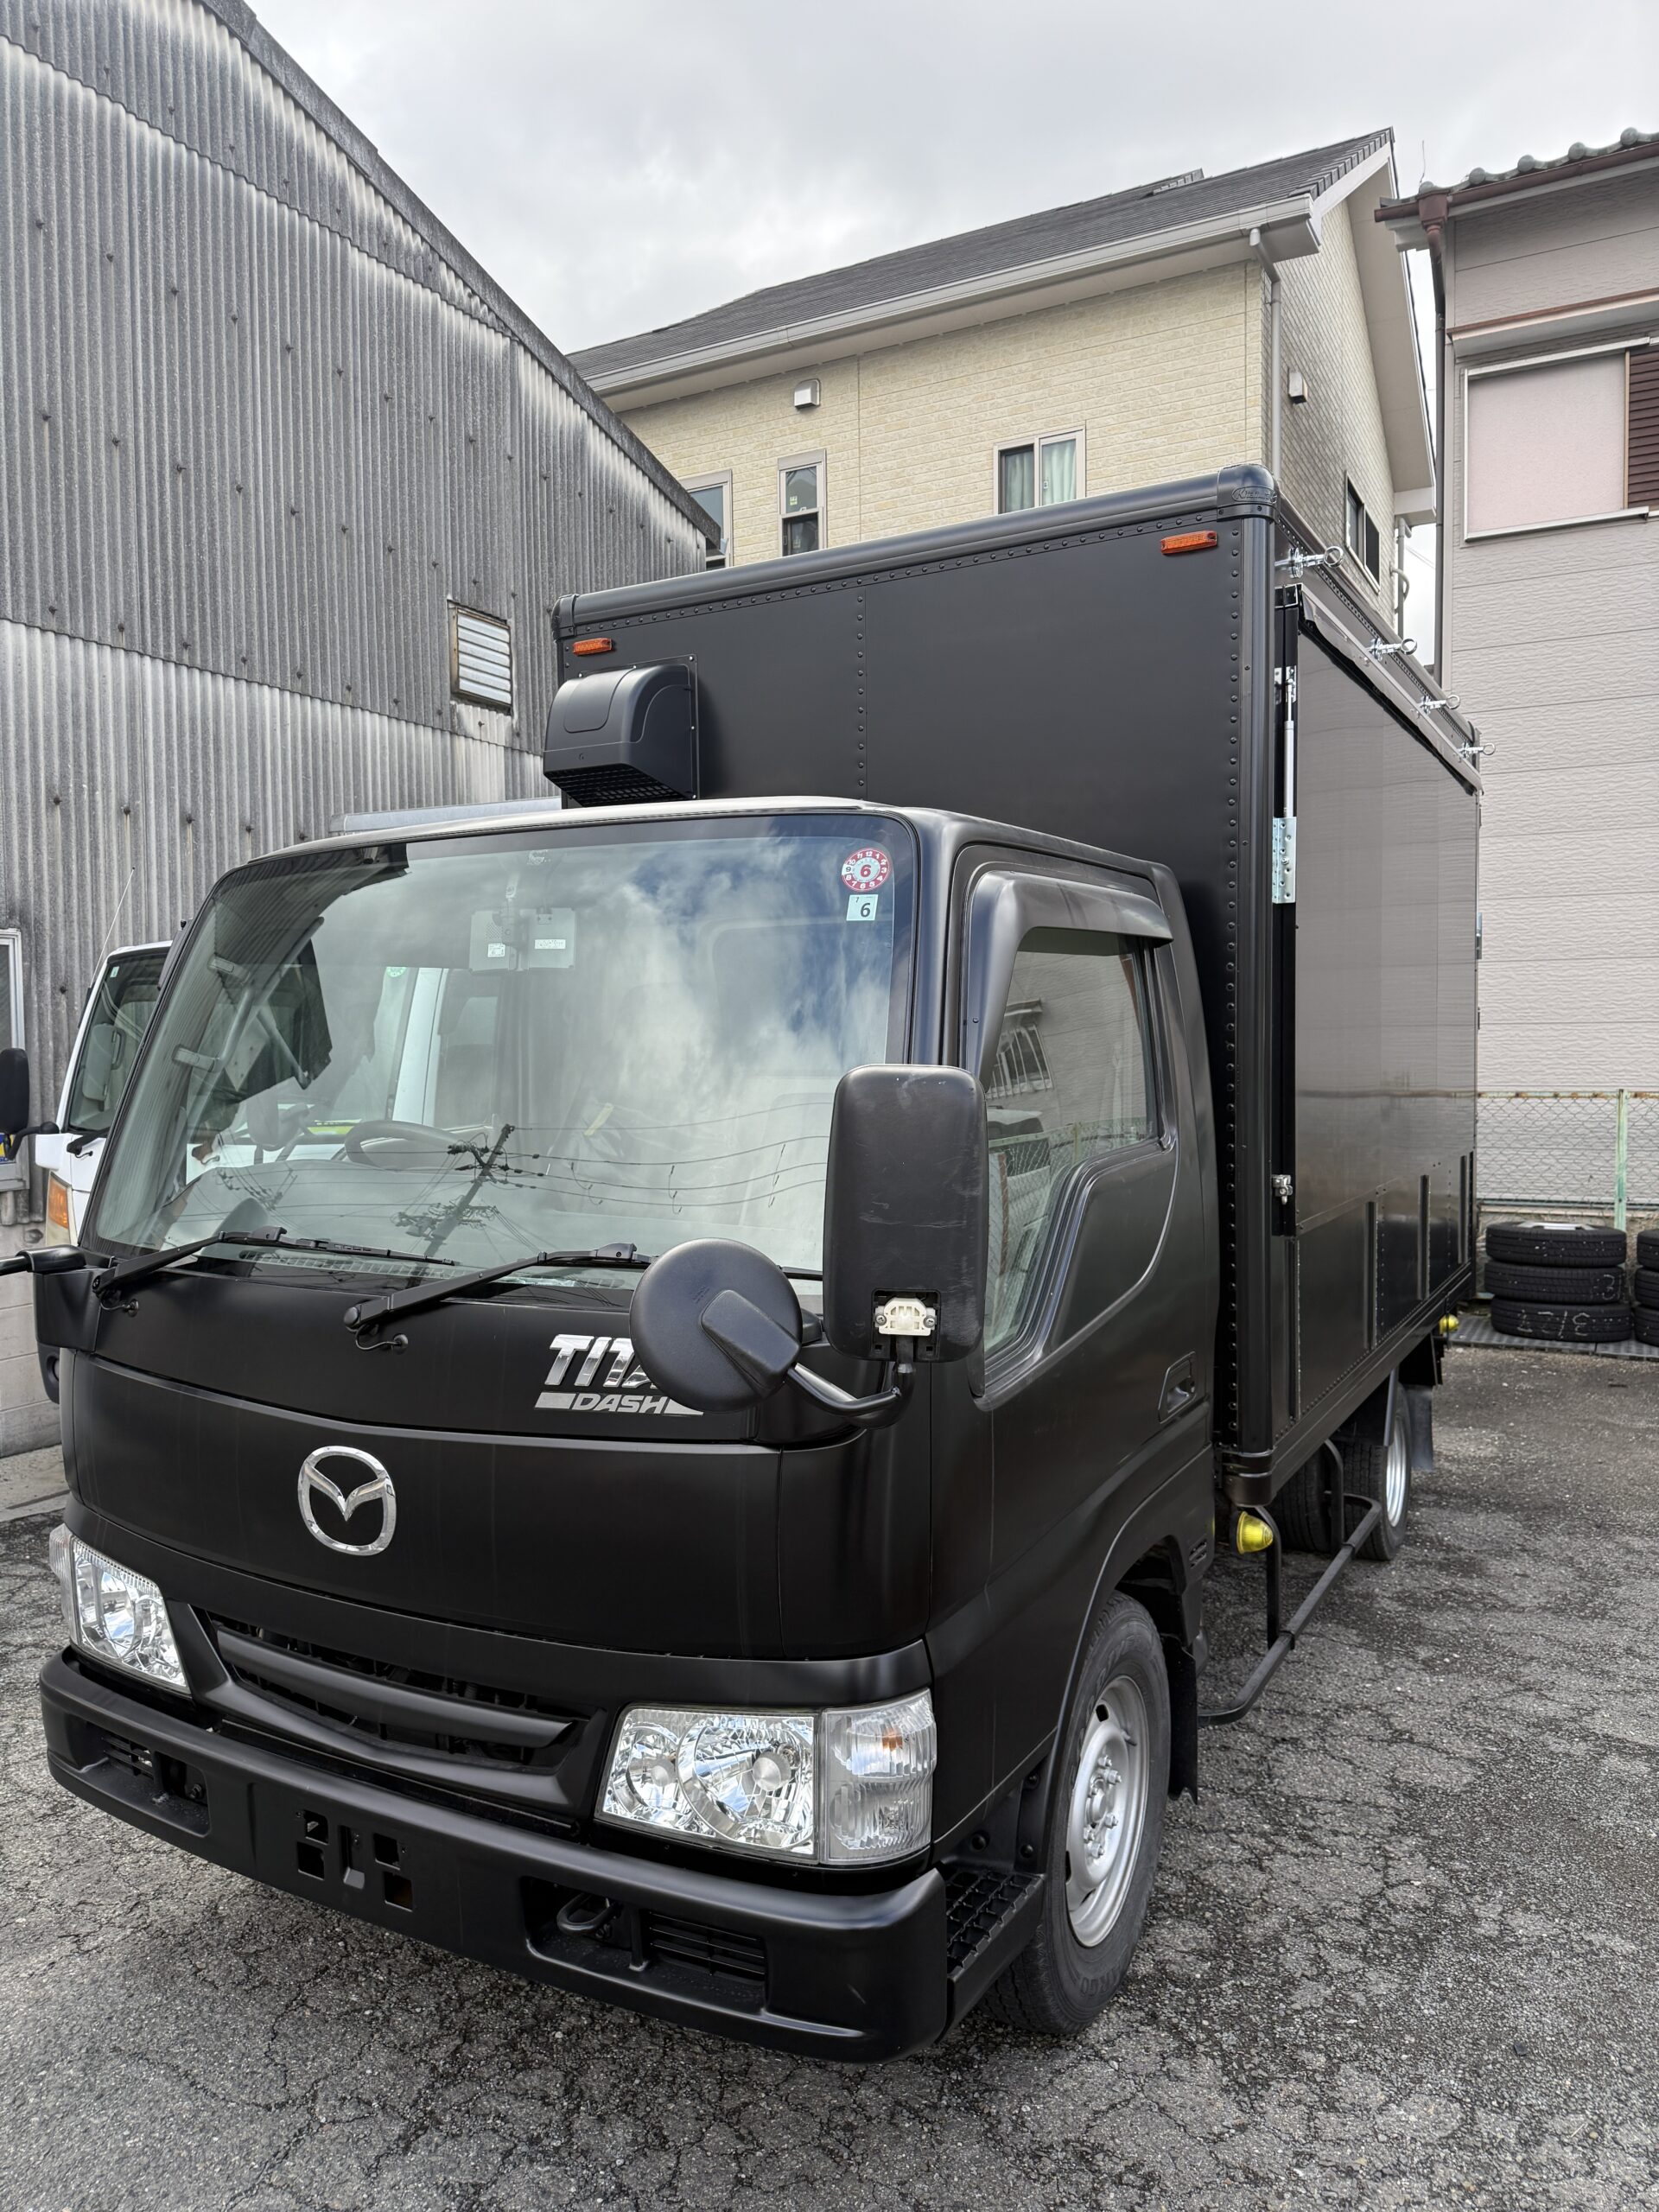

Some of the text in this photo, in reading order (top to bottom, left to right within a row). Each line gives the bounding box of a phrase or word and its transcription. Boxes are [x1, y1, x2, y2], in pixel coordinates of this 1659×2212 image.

[861, 864, 871, 877] 6
[861, 903, 870, 917] 6
[572, 1393, 668, 1414] DASH
